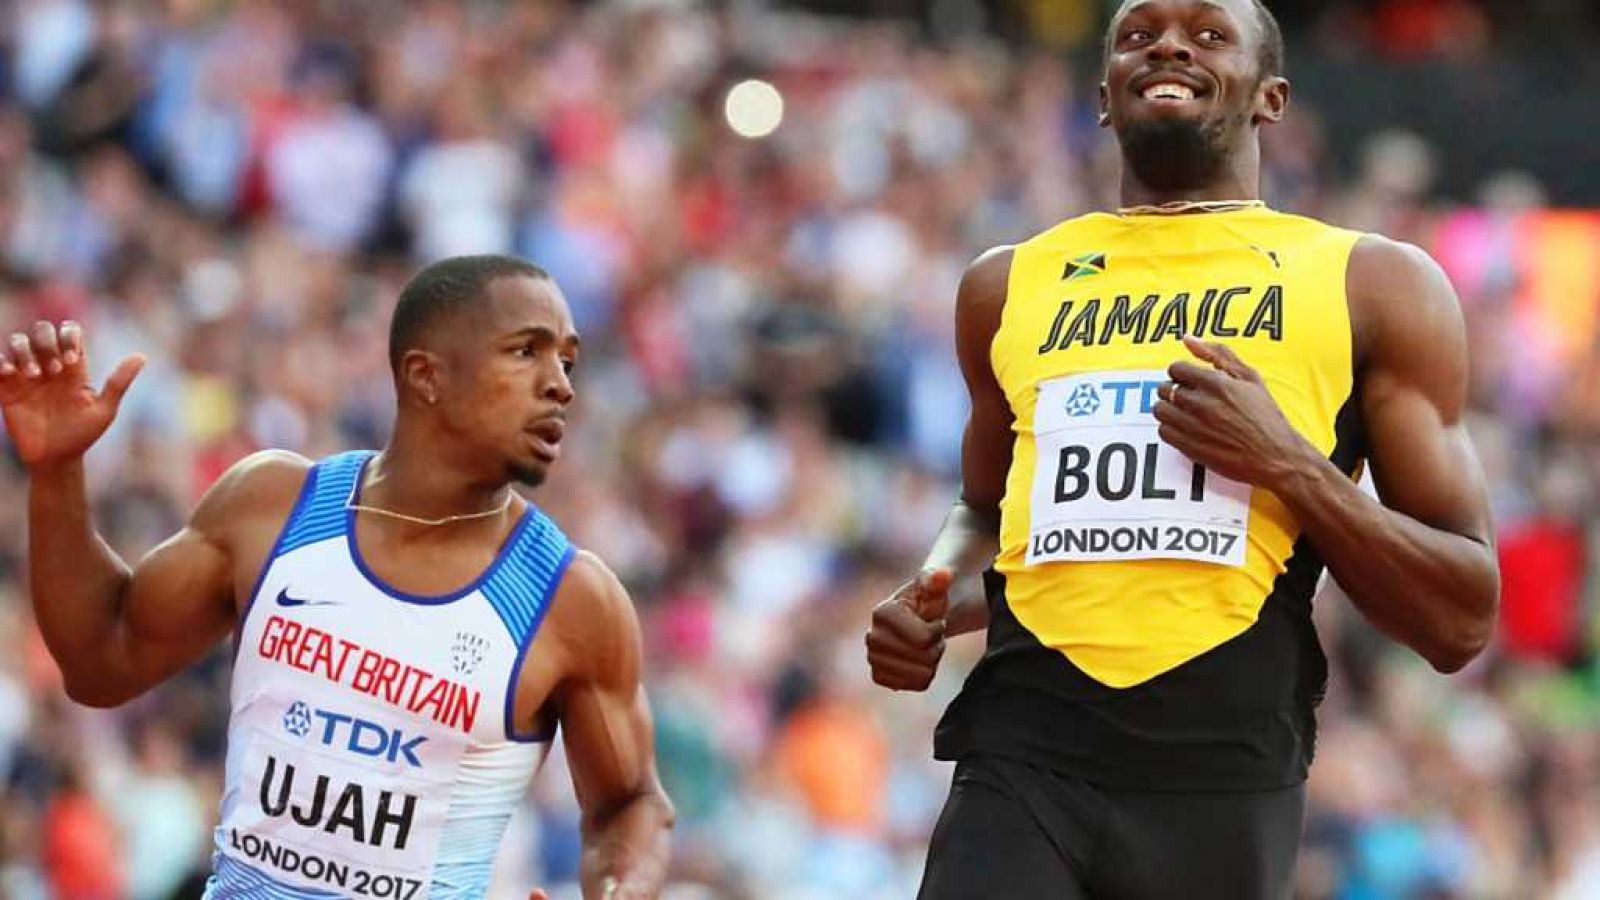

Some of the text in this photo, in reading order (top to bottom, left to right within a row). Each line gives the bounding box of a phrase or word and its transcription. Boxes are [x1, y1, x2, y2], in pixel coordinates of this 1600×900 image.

[1038, 285, 1283, 355] JAMAICA
[1033, 527, 1238, 557] LONDON 2017
[259, 615, 481, 733] GREAT BRITAIN
[315, 709, 428, 768] TDK
[260, 756, 418, 850] UJAH
[231, 828, 423, 900] LONDON 2017
